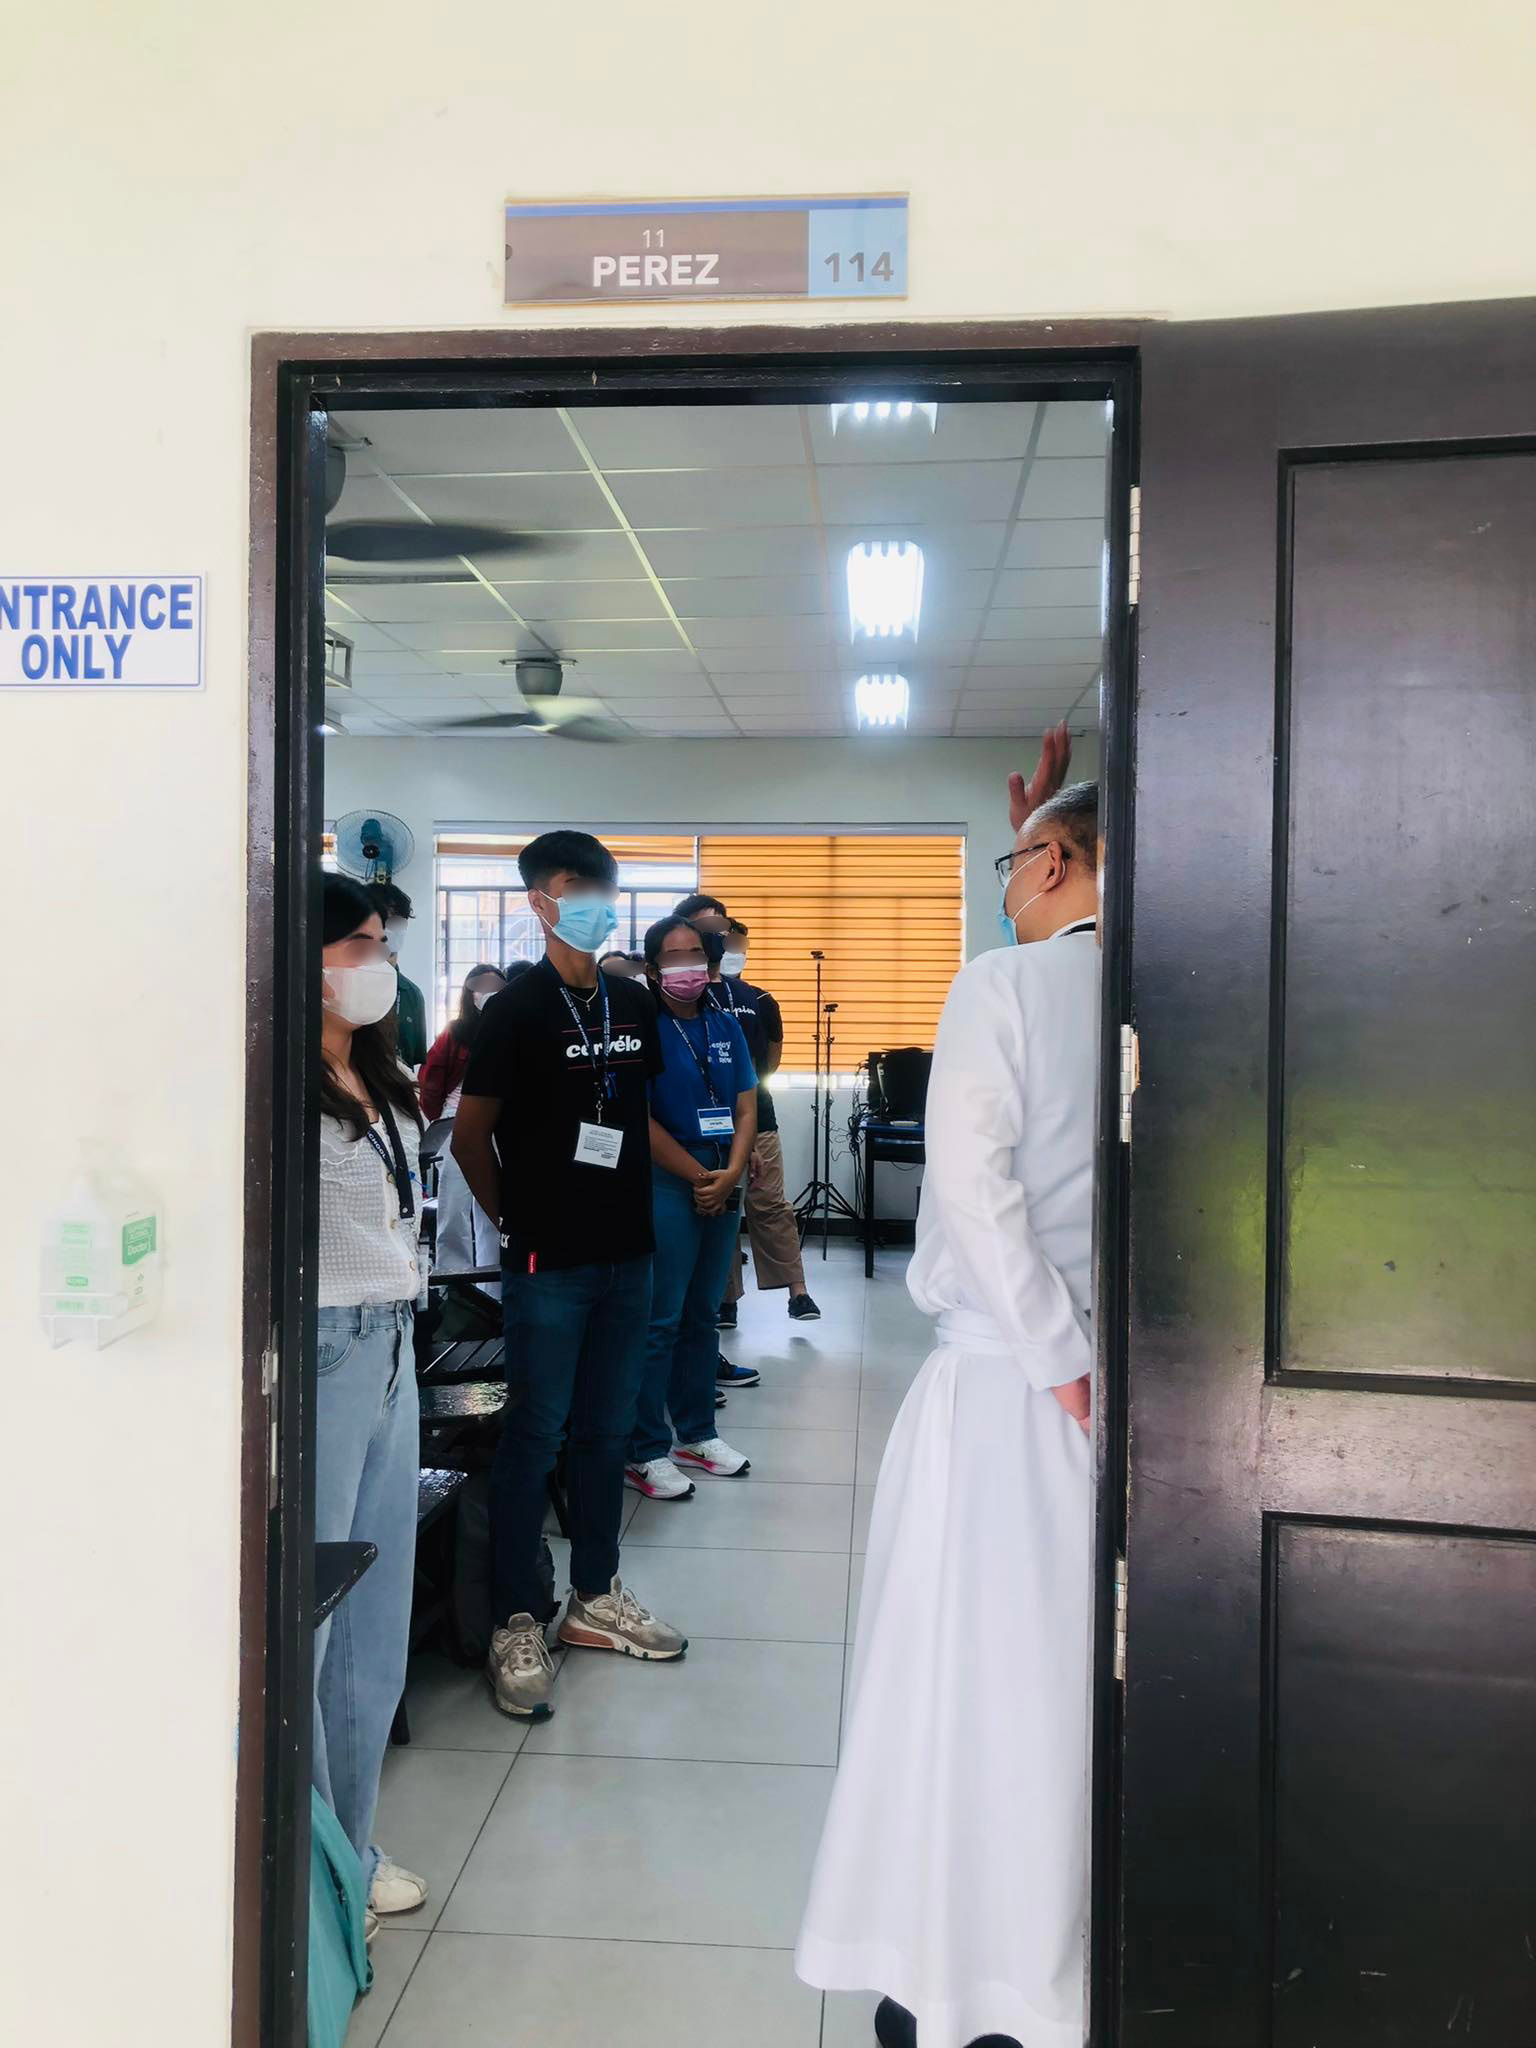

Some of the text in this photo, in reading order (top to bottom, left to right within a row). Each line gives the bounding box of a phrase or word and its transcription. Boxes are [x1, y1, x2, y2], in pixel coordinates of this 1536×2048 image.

[642, 229, 666, 248] 11
[592, 254, 720, 288] PEREZ
[823, 251, 895, 284] 114
[21, 634, 133, 680] ONLY
